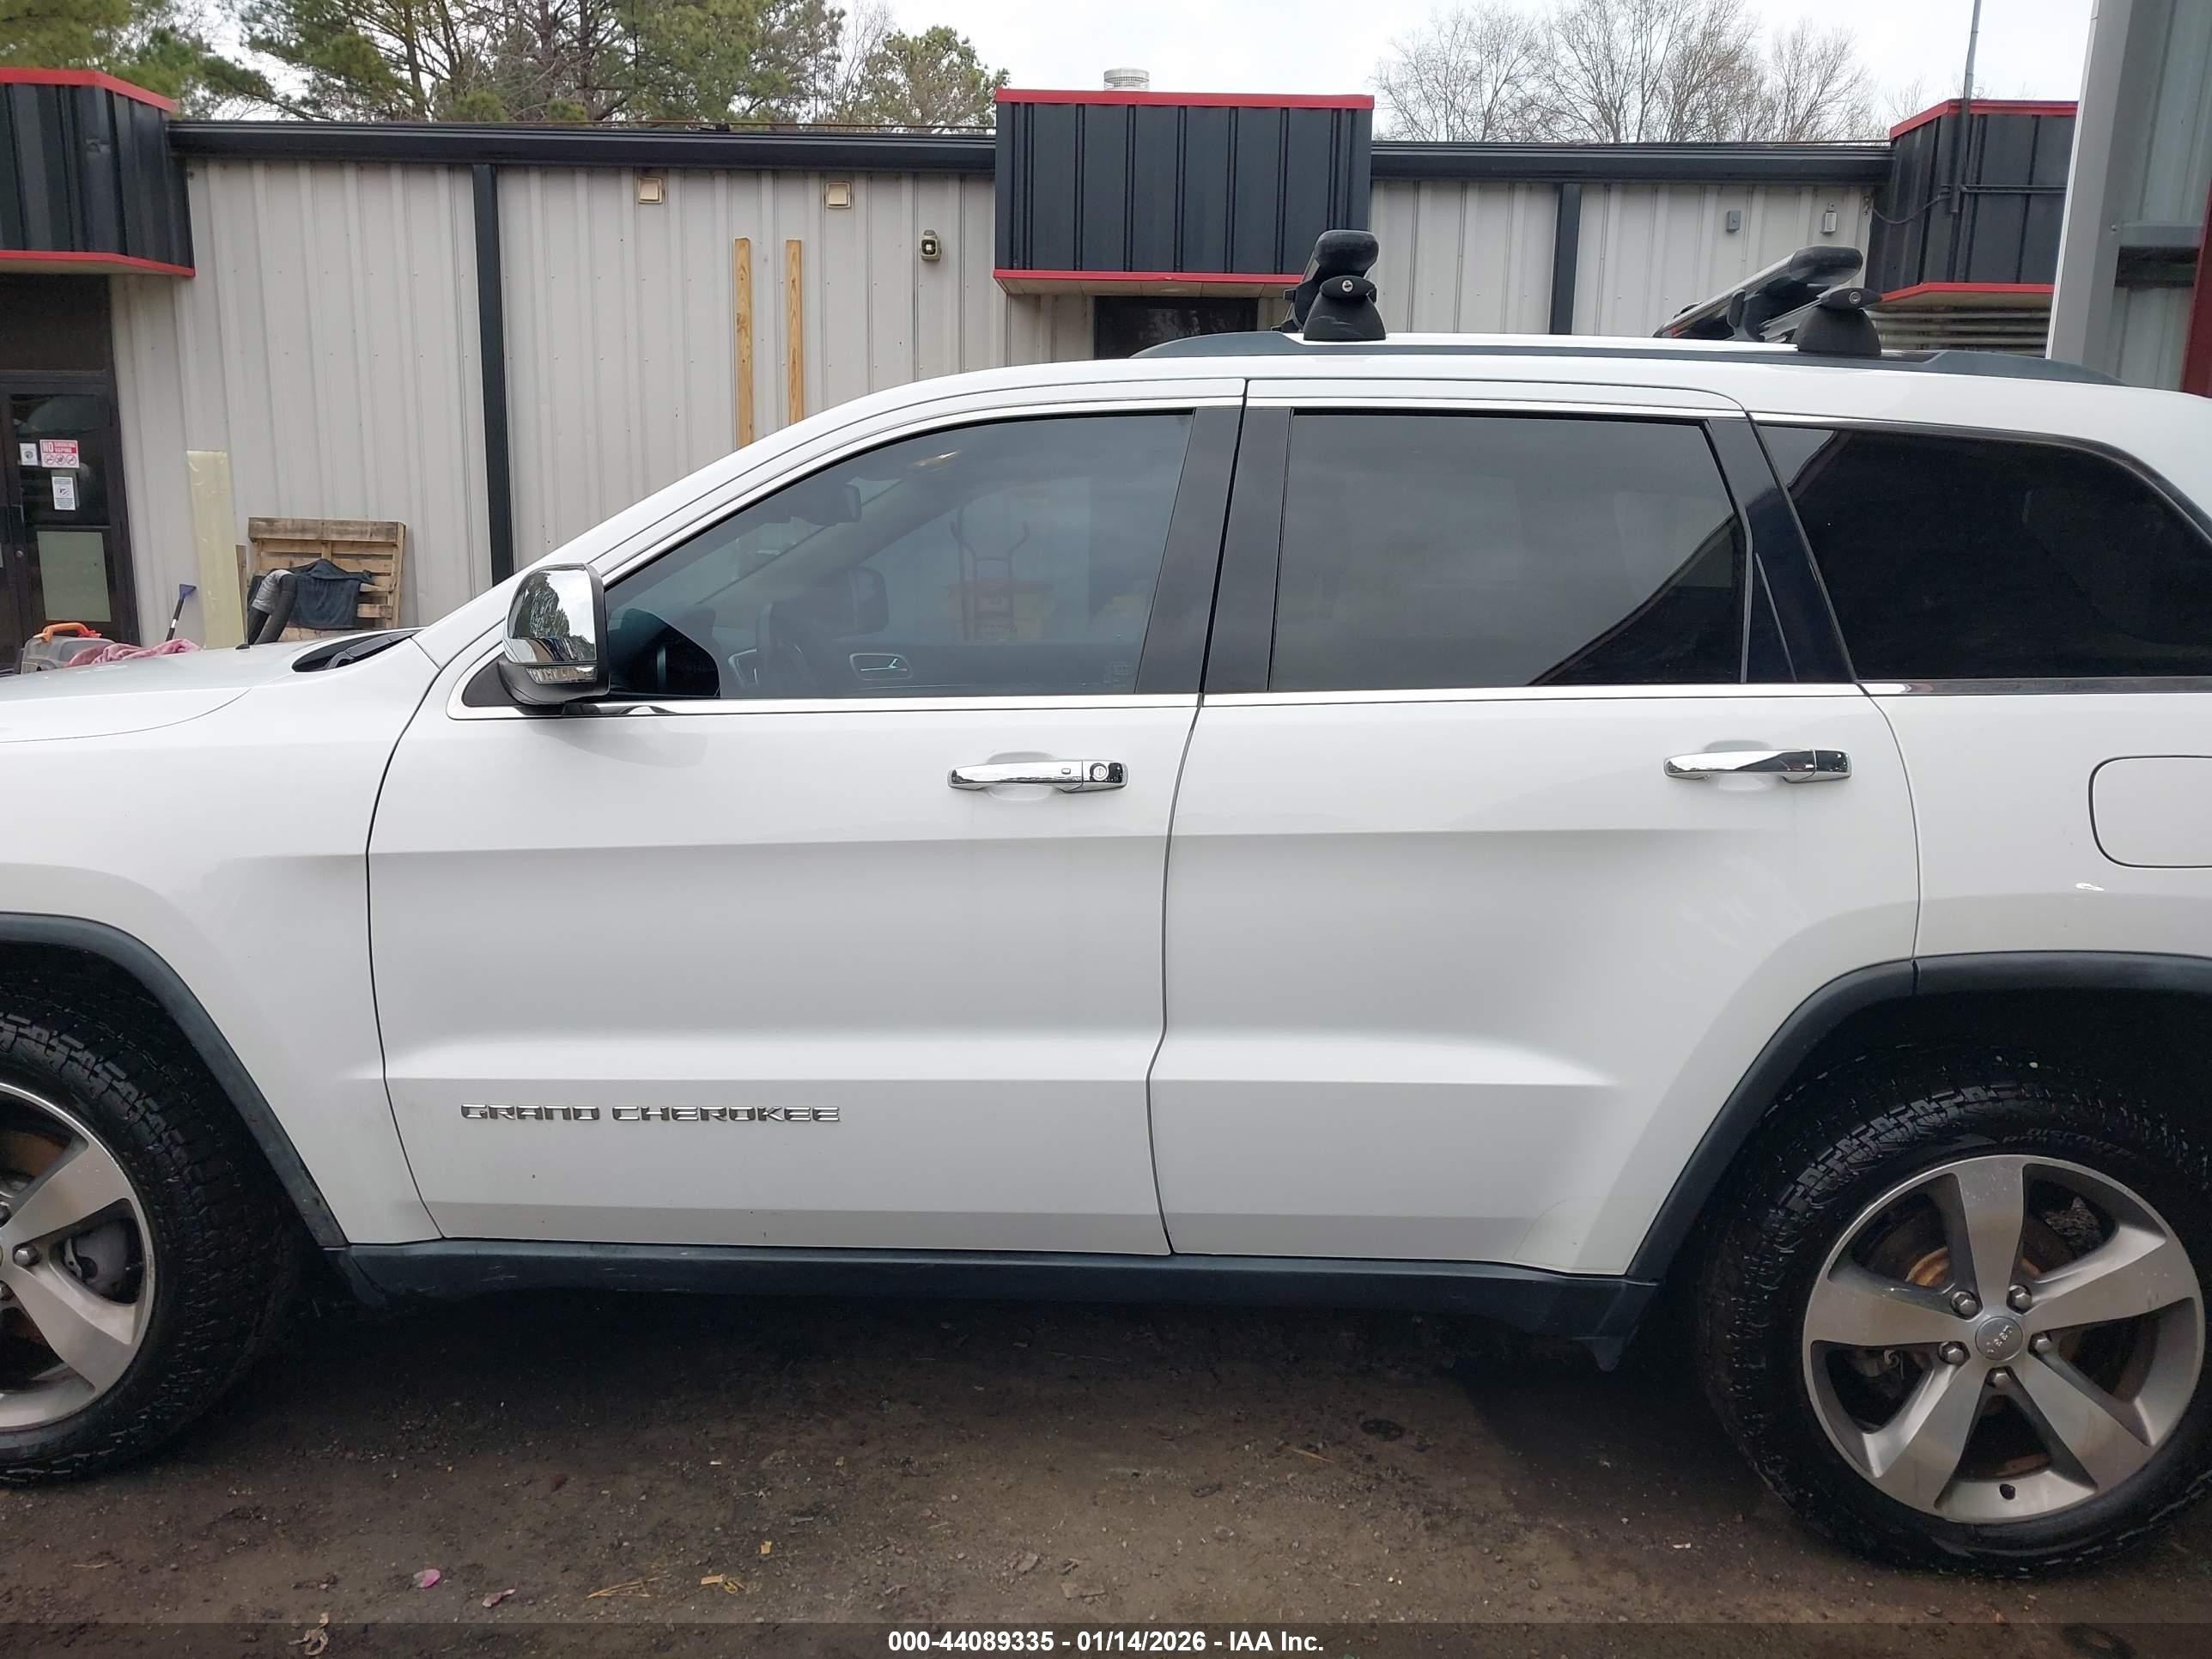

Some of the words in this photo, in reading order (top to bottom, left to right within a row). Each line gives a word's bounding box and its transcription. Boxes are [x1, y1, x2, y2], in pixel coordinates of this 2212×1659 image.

[42, 441, 54, 453] NO
[460, 1103, 599, 1121] GRAND
[611, 1105, 841, 1121] CHEROKEE
